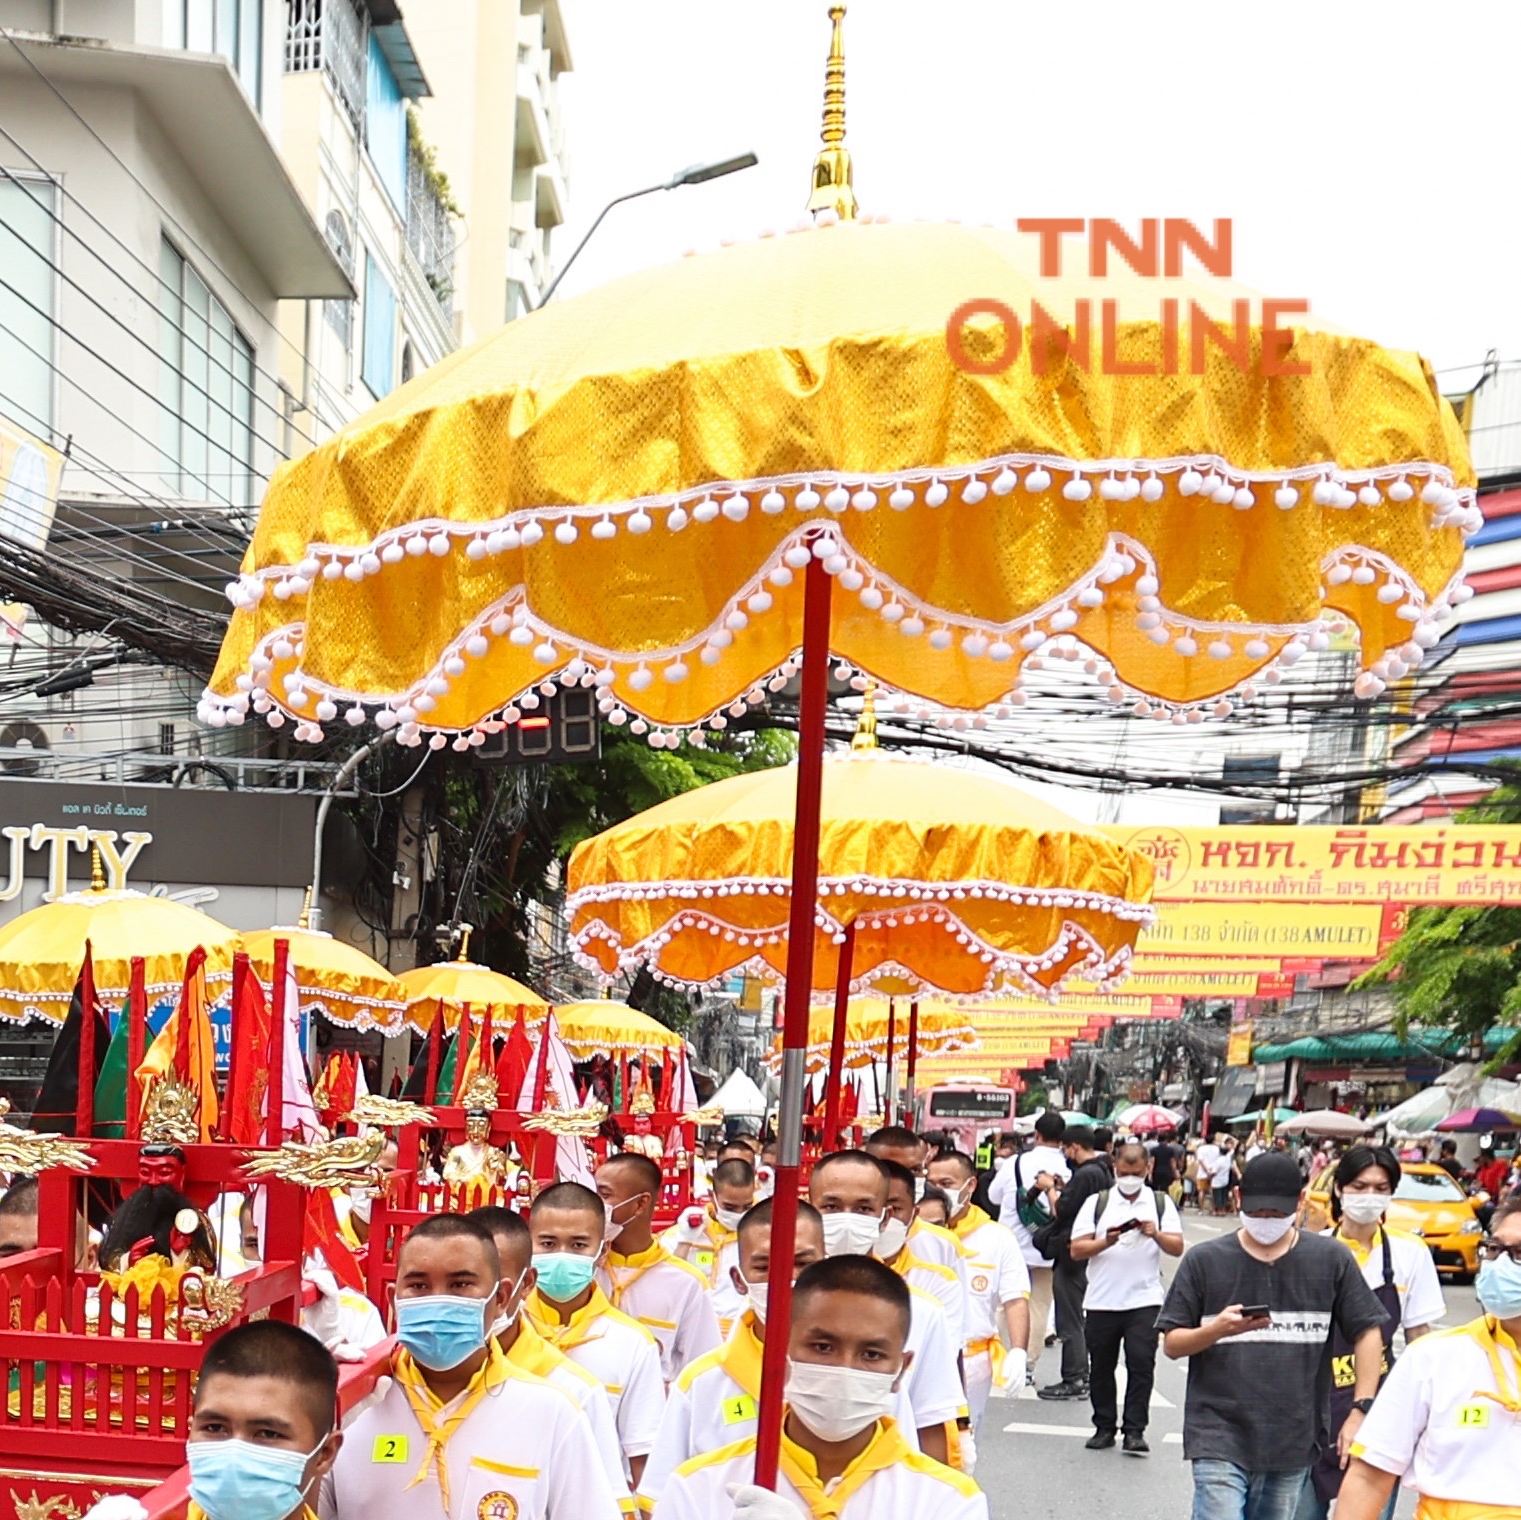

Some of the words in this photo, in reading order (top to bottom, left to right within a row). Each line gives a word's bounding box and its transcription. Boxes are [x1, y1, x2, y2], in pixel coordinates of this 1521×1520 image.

[1199, 839, 1308, 869] หจก.
[1183, 924, 1211, 941] 138
[1219, 918, 1260, 943] จำกัด
[732, 1402, 744, 1417] 4
[1462, 1408, 1482, 1424] 12
[383, 1440, 397, 1458] 2
